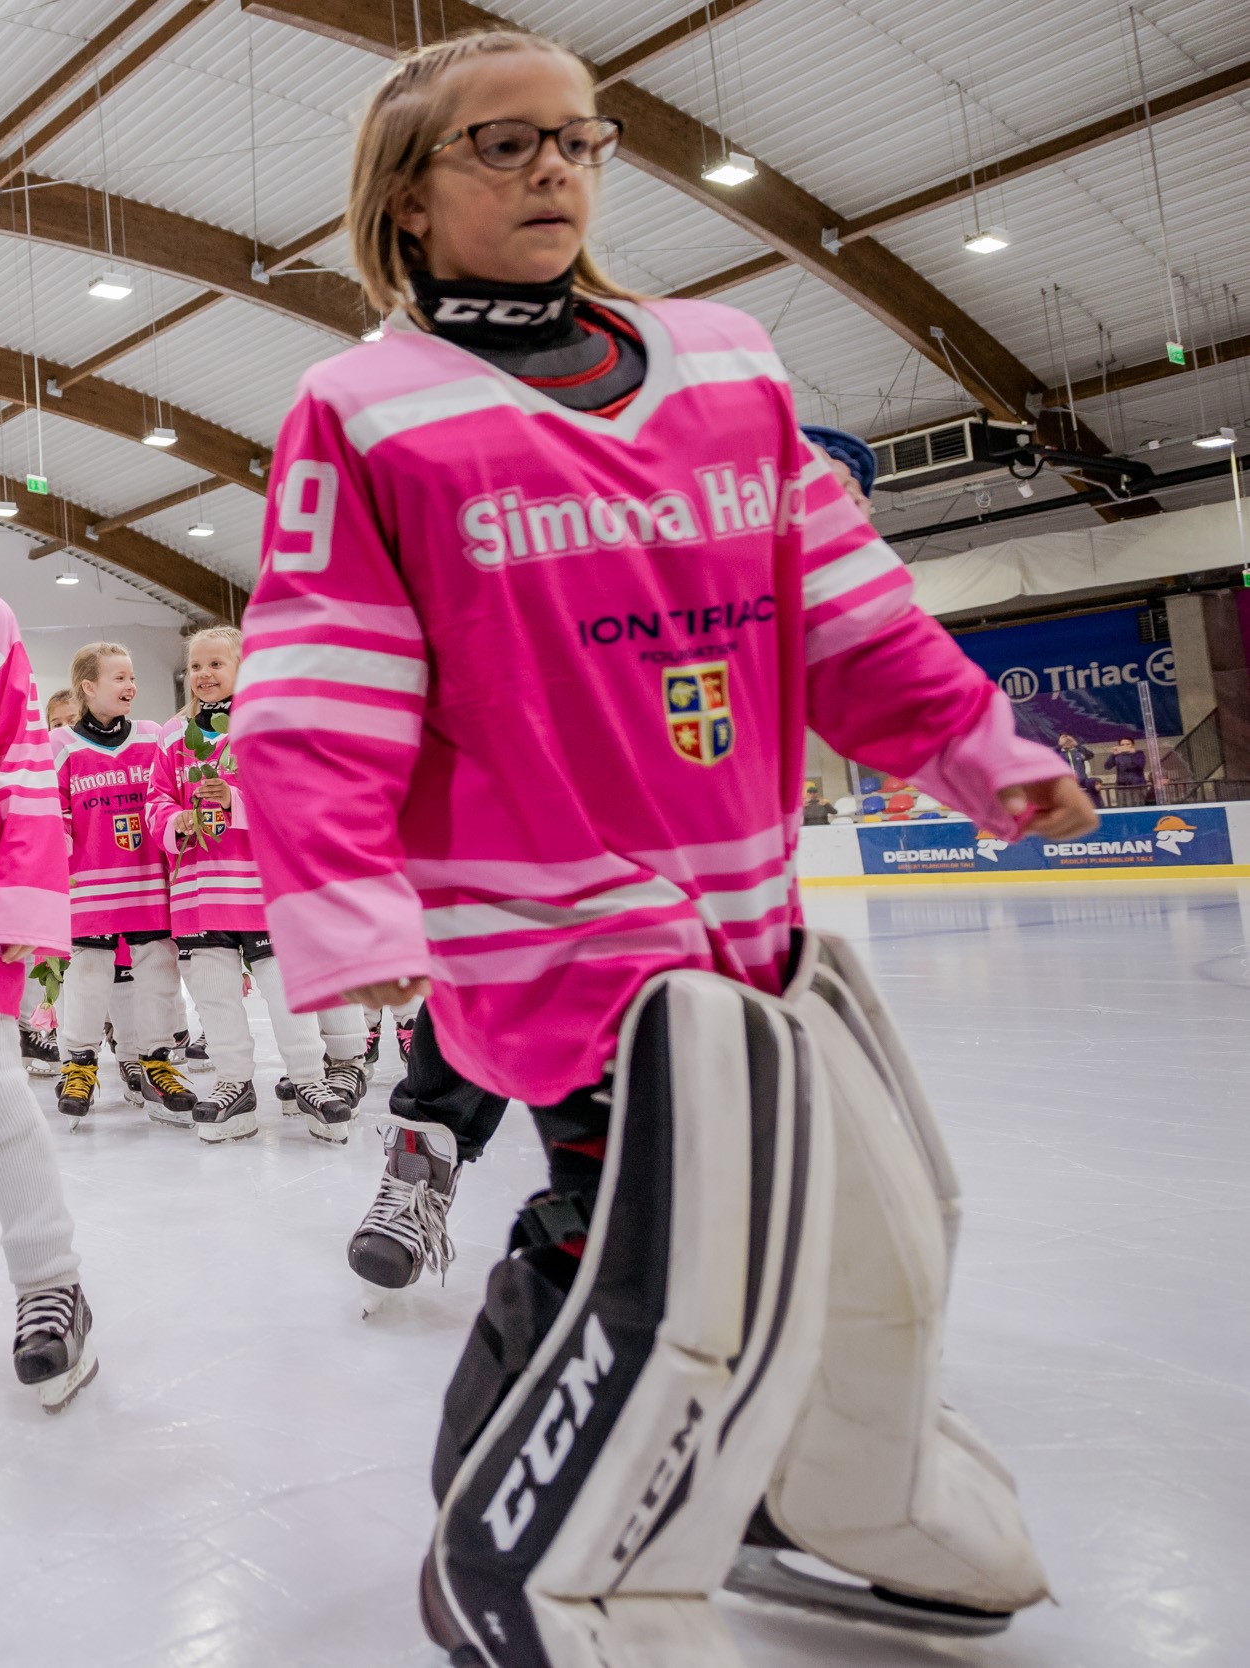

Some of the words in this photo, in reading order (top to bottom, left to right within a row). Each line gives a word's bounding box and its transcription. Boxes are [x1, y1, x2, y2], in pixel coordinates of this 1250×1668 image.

[458, 486, 706, 572] Simona
[579, 611, 660, 647] ION
[83, 796, 110, 810] ION
[882, 848, 975, 864] DEDEMAN
[1043, 840, 1153, 857] DEDEMAN
[481, 1311, 616, 1552] CCM
